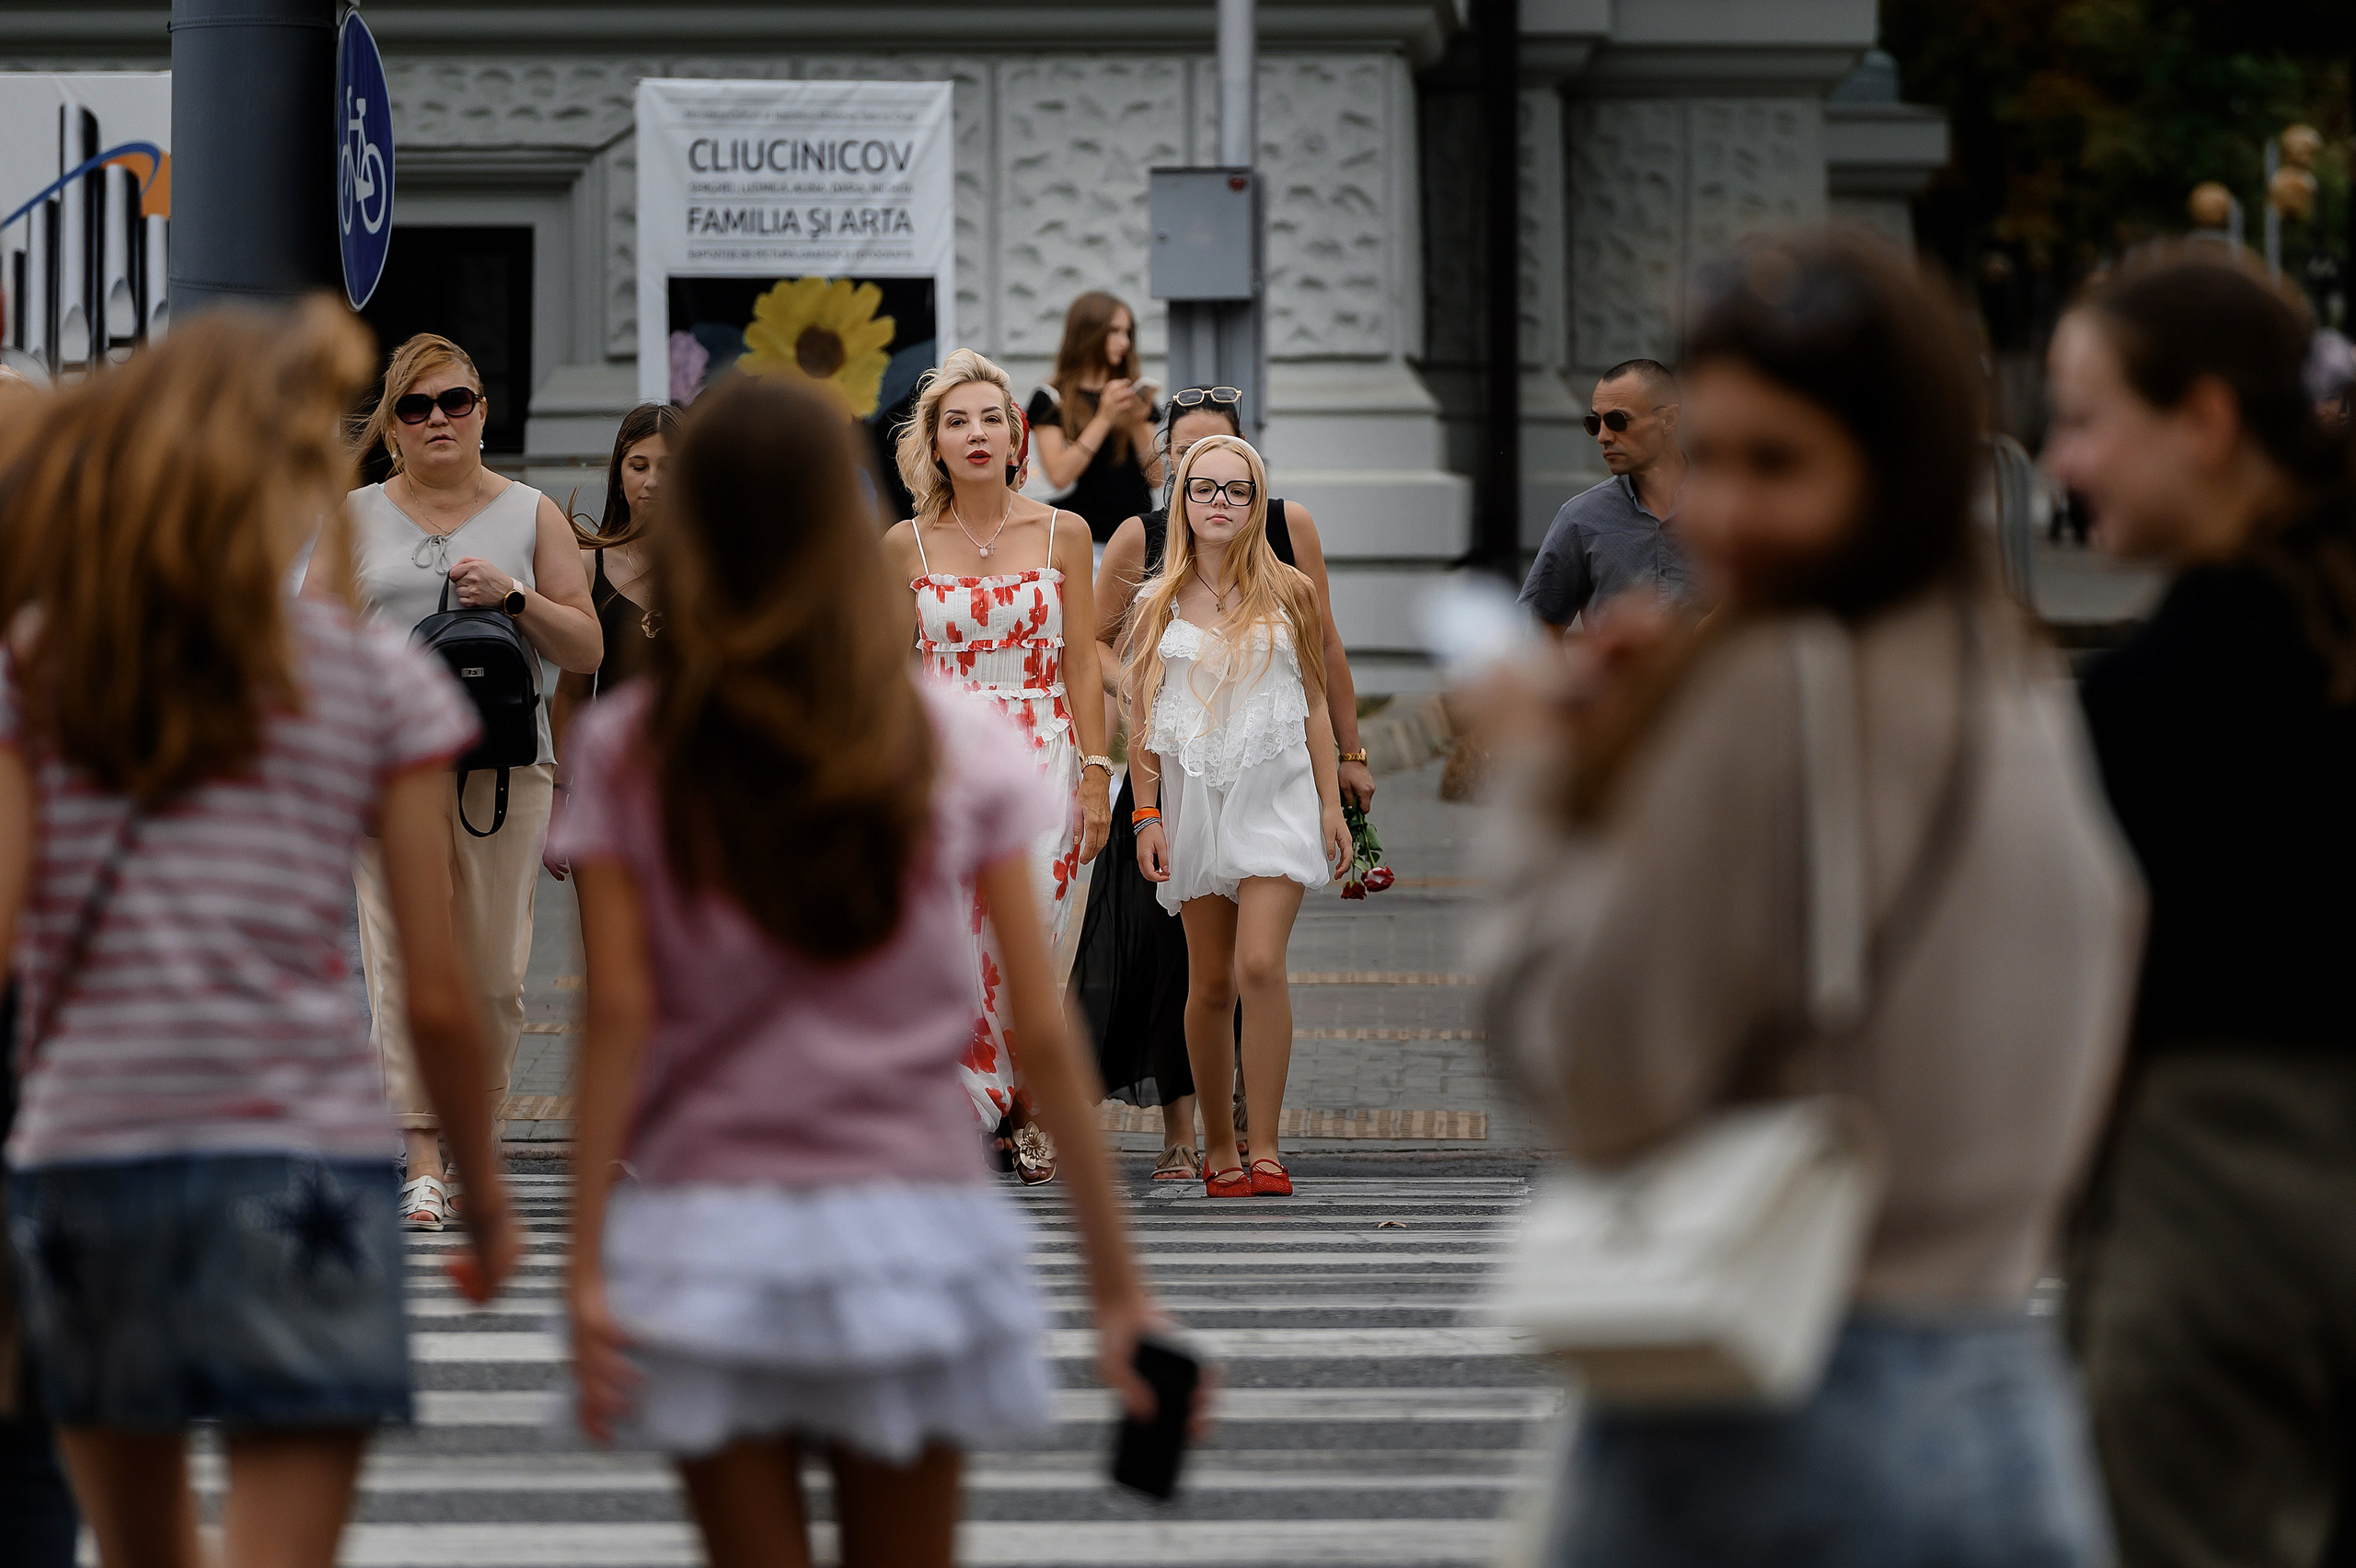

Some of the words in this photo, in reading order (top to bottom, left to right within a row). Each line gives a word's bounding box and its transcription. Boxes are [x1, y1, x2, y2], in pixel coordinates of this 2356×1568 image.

[687, 137, 913, 174] CLIUCINICOV
[687, 206, 802, 236] FAMILIA
[837, 207, 914, 236] ARTA
